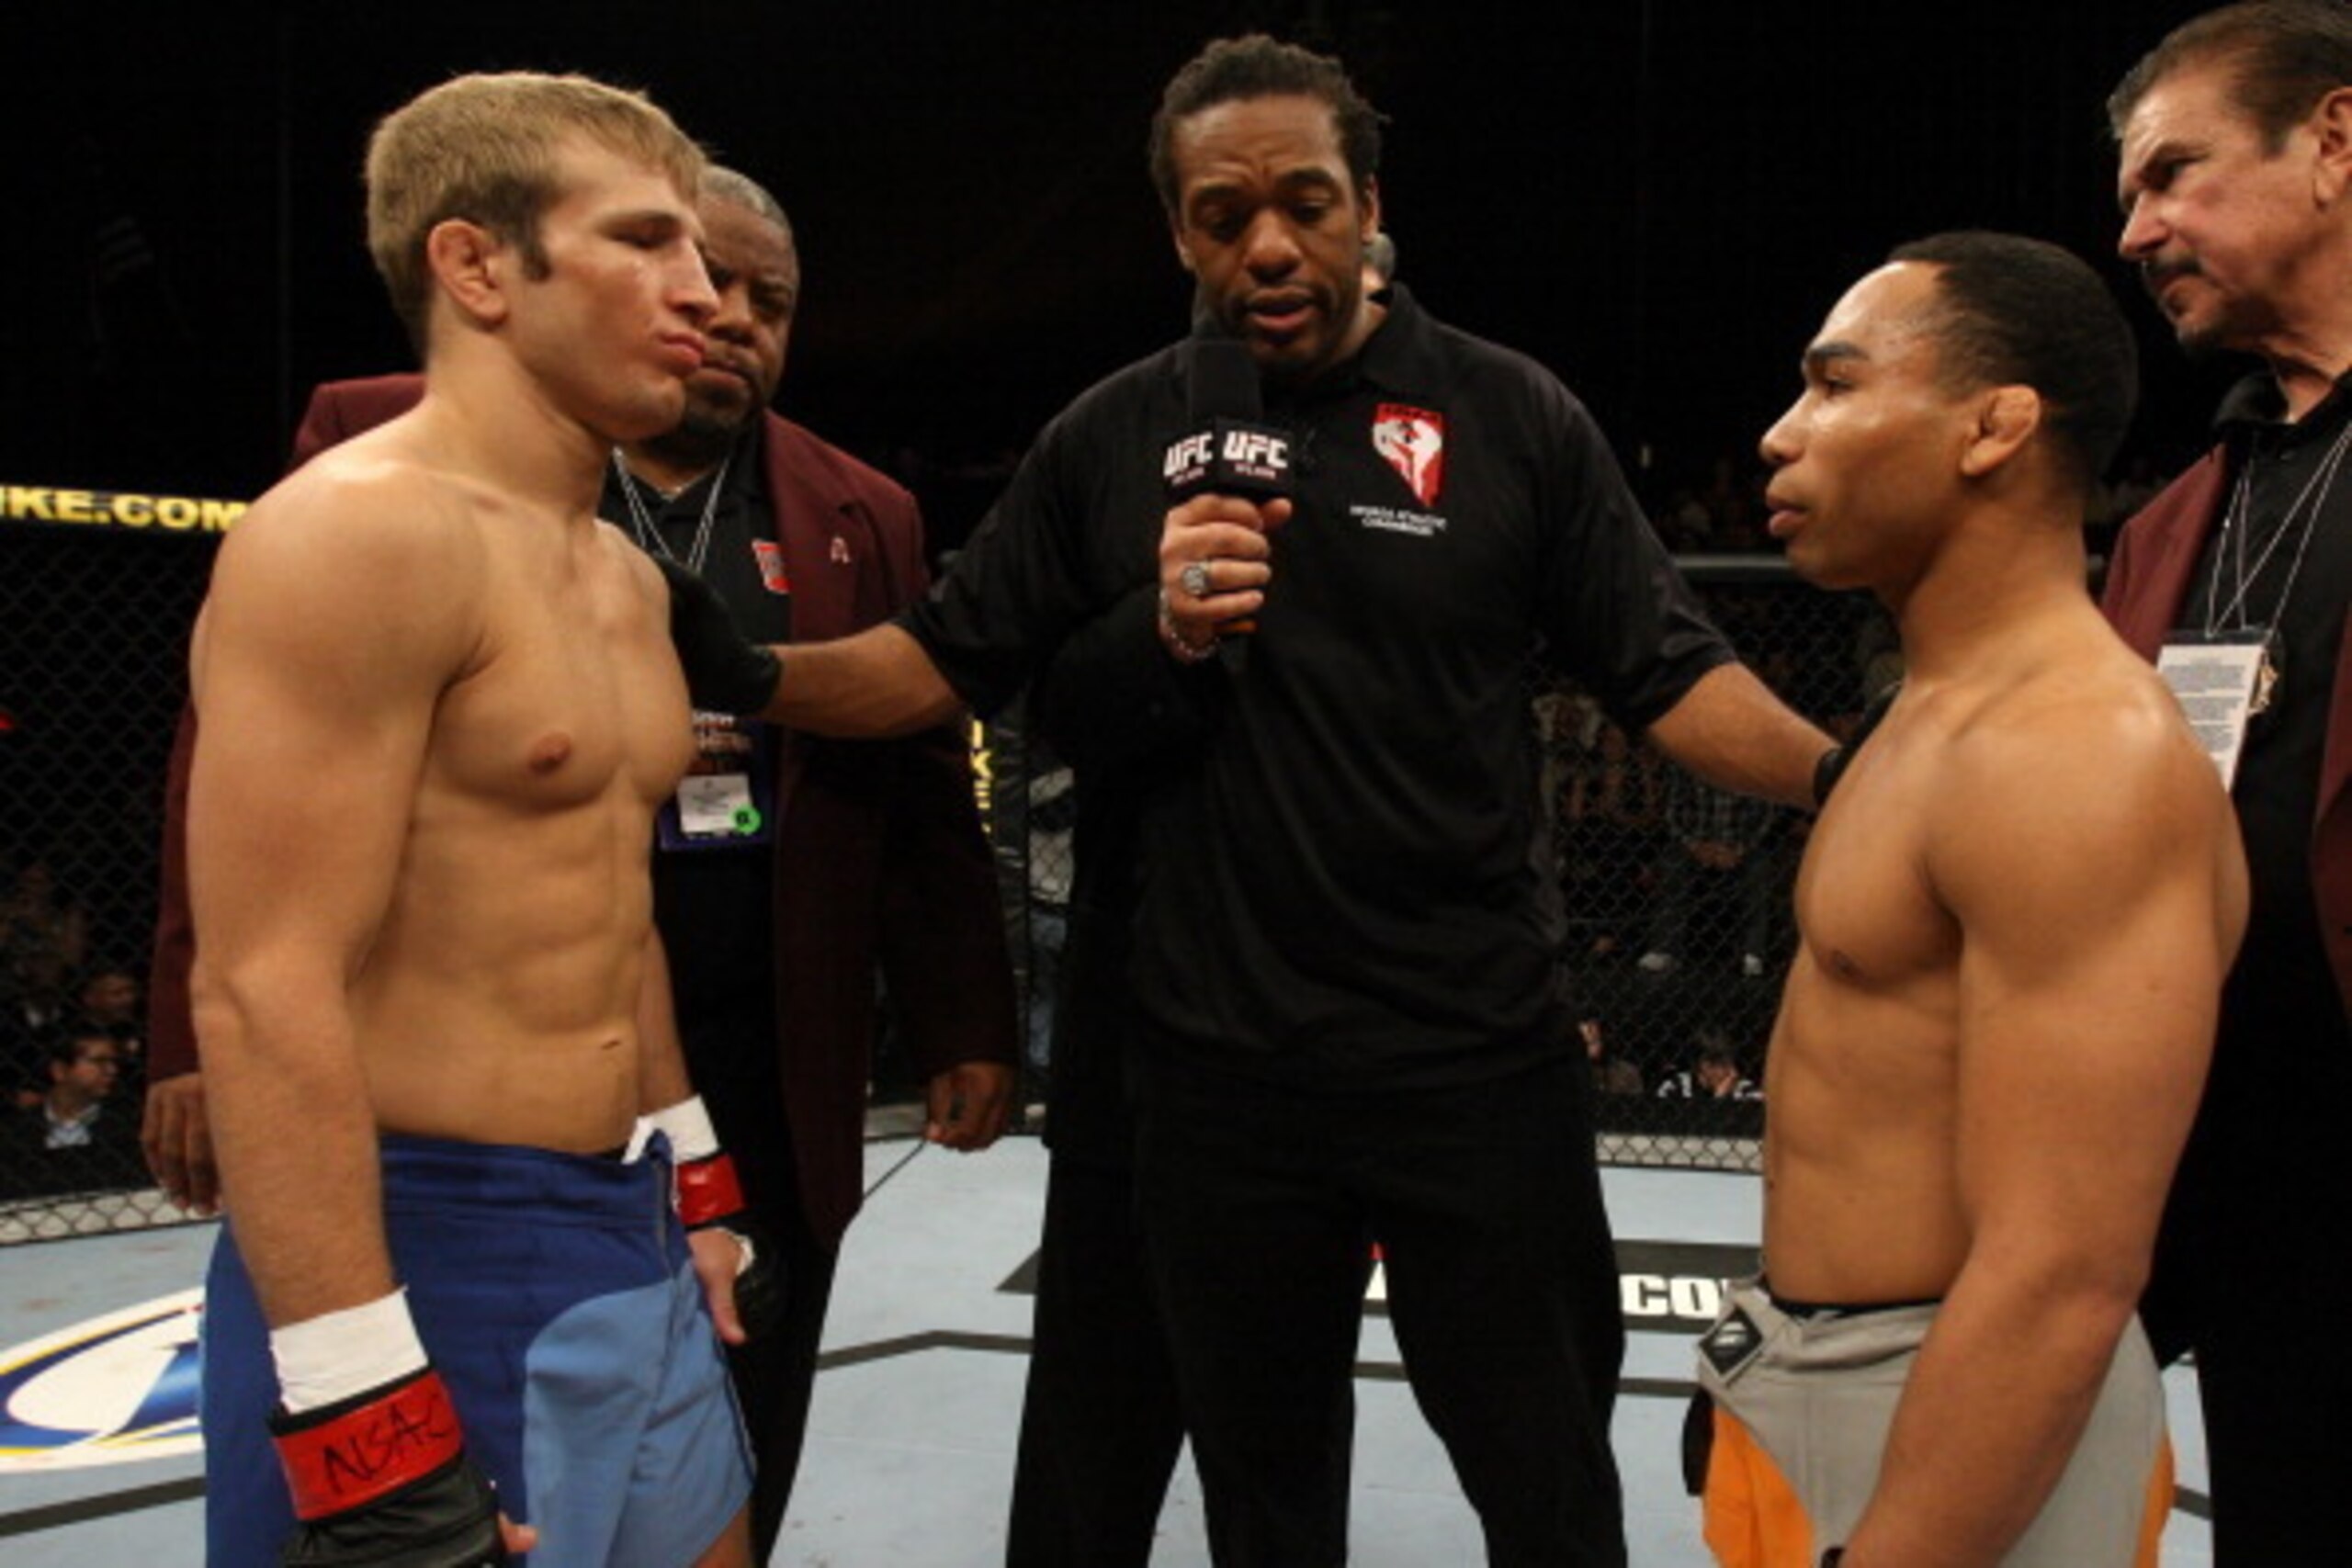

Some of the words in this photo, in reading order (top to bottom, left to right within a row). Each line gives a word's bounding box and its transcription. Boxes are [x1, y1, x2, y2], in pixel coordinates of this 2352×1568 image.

[1163, 432, 1214, 477] UFC
[1223, 430, 1288, 469] UFC
[1620, 1274, 1728, 1317] CO
